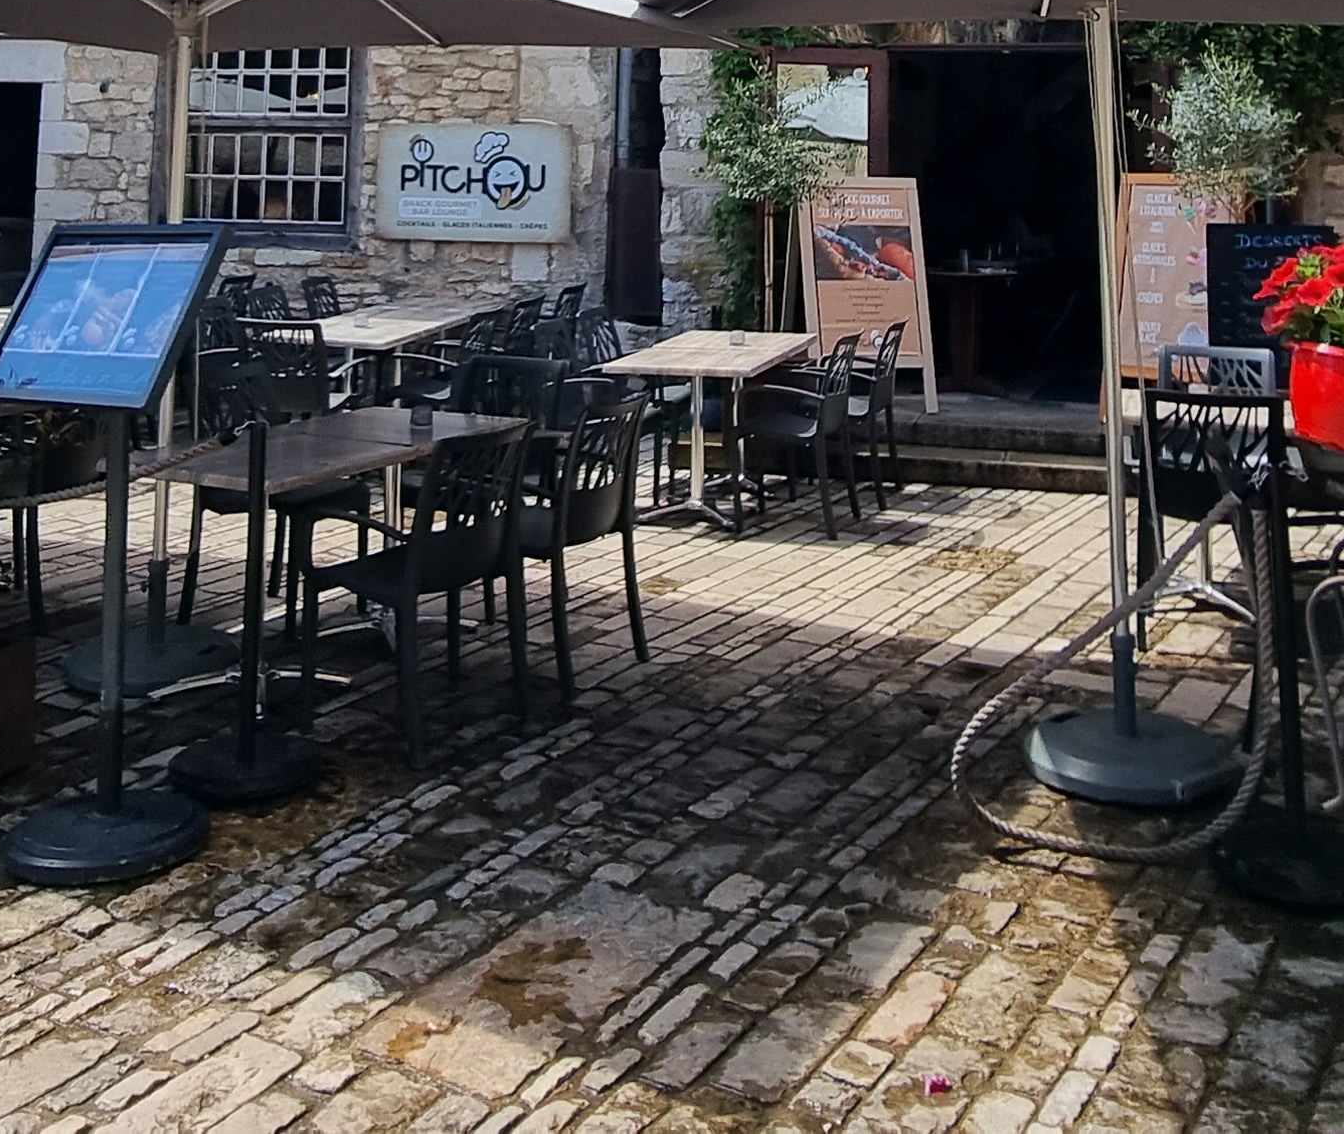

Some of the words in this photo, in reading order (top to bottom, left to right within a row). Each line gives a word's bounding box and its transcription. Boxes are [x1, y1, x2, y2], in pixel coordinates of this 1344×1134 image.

[400, 139, 546, 207] PITCHOU
[434, 200, 478, 209] GOURMET
[432, 208, 468, 217] LOUNGE
[396, 220, 436, 228] COCKTAILS
